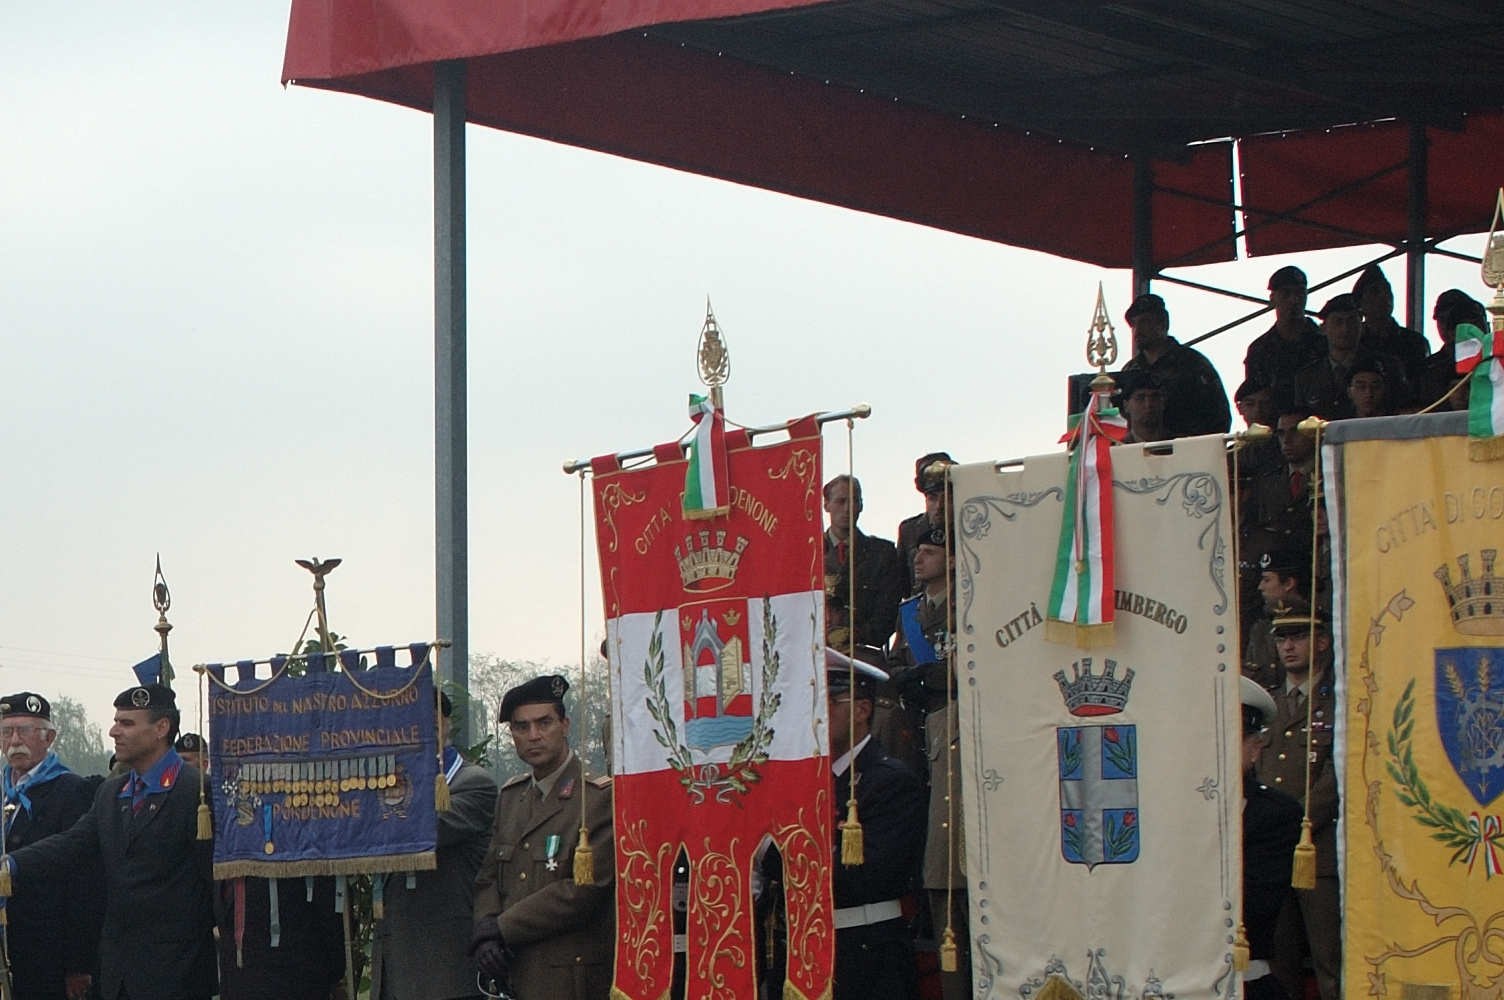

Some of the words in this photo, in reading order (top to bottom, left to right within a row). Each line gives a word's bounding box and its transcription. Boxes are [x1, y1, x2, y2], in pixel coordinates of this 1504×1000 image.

[1445, 492, 1464, 525] DI
[995, 601, 1044, 648] CITTÀ
[1114, 589, 1188, 636] IMBERGO
[213, 696, 268, 717] ISTITUTO
[292, 692, 346, 715] NASTRO
[222, 733, 310, 757] FEDERAZIONE
[321, 725, 419, 749] PROVINCIALE
